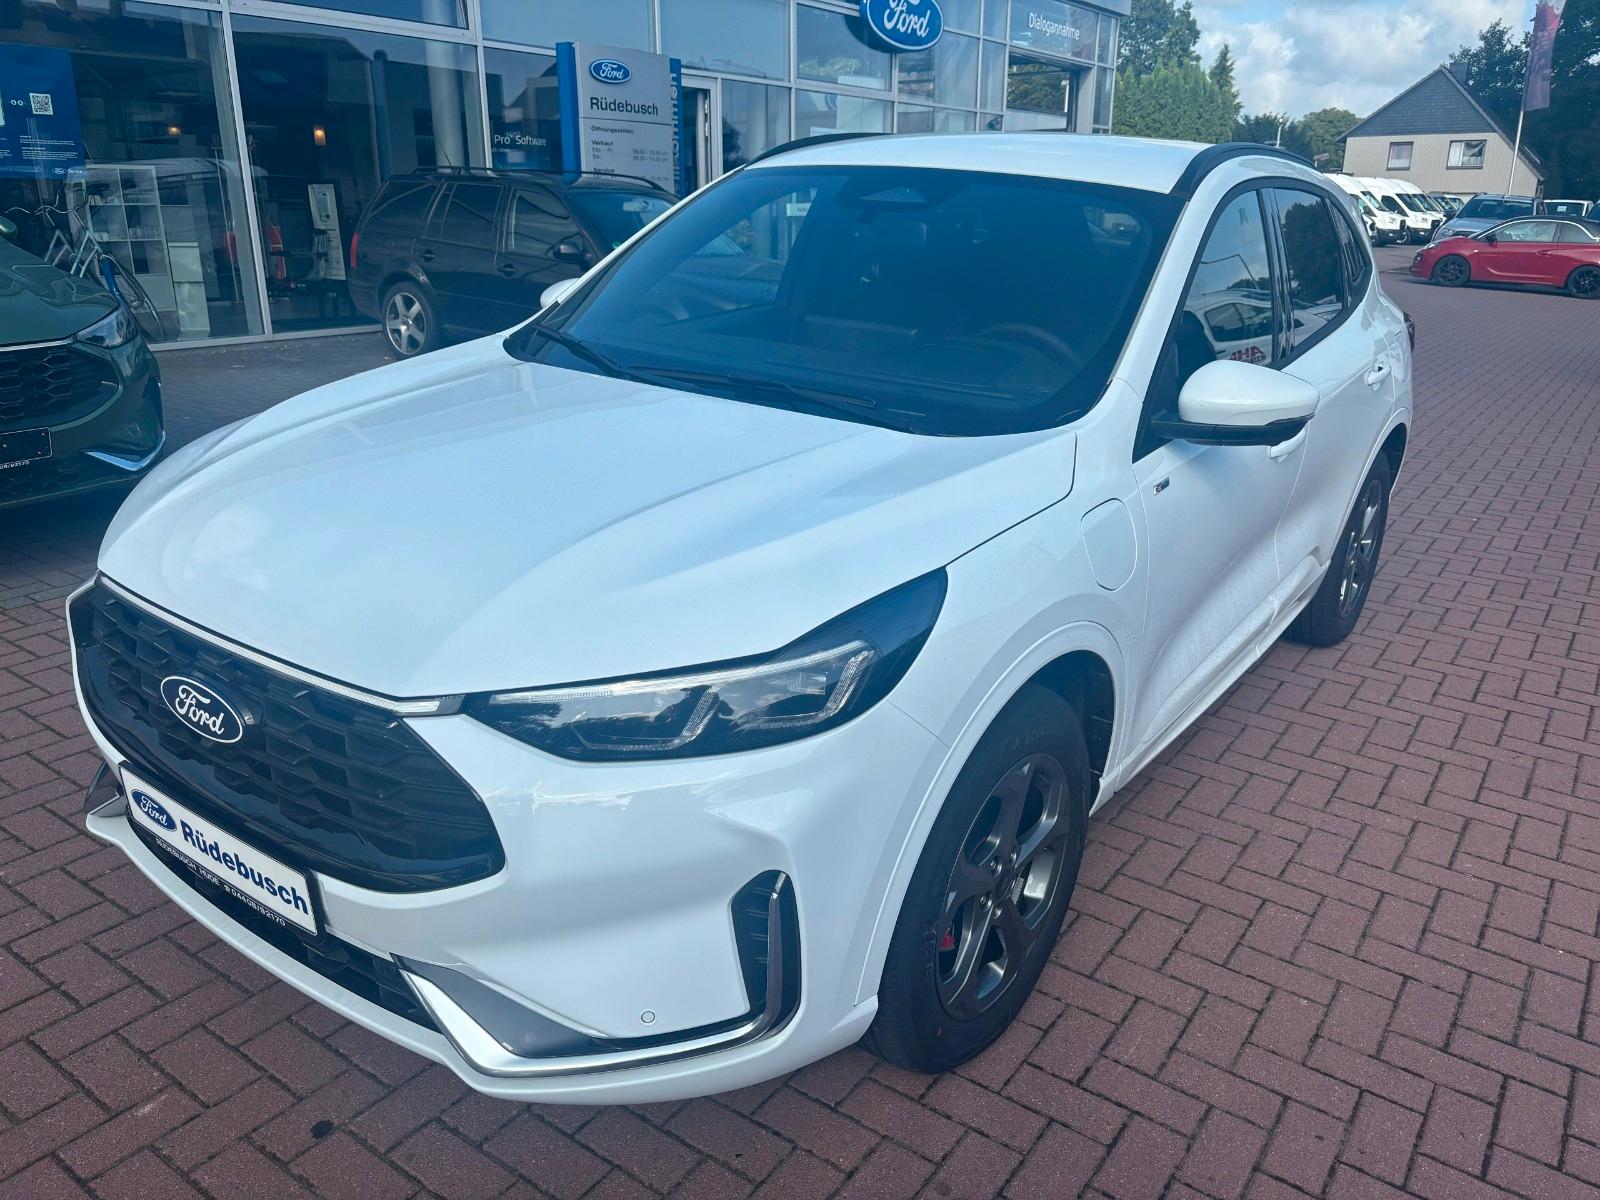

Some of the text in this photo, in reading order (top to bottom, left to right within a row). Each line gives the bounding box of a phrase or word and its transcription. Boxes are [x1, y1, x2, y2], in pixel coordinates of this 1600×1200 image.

[884, 0, 930, 38] Ford
[1028, 12, 1080, 41] Dialogannahme
[600, 62, 625, 79] Ford
[590, 96, 658, 116] Rüdebusch
[515, 135, 547, 146] Software
[175, 684, 225, 735] Ford
[139, 796, 168, 828] Ford
[179, 819, 309, 915] Rüdebusch
